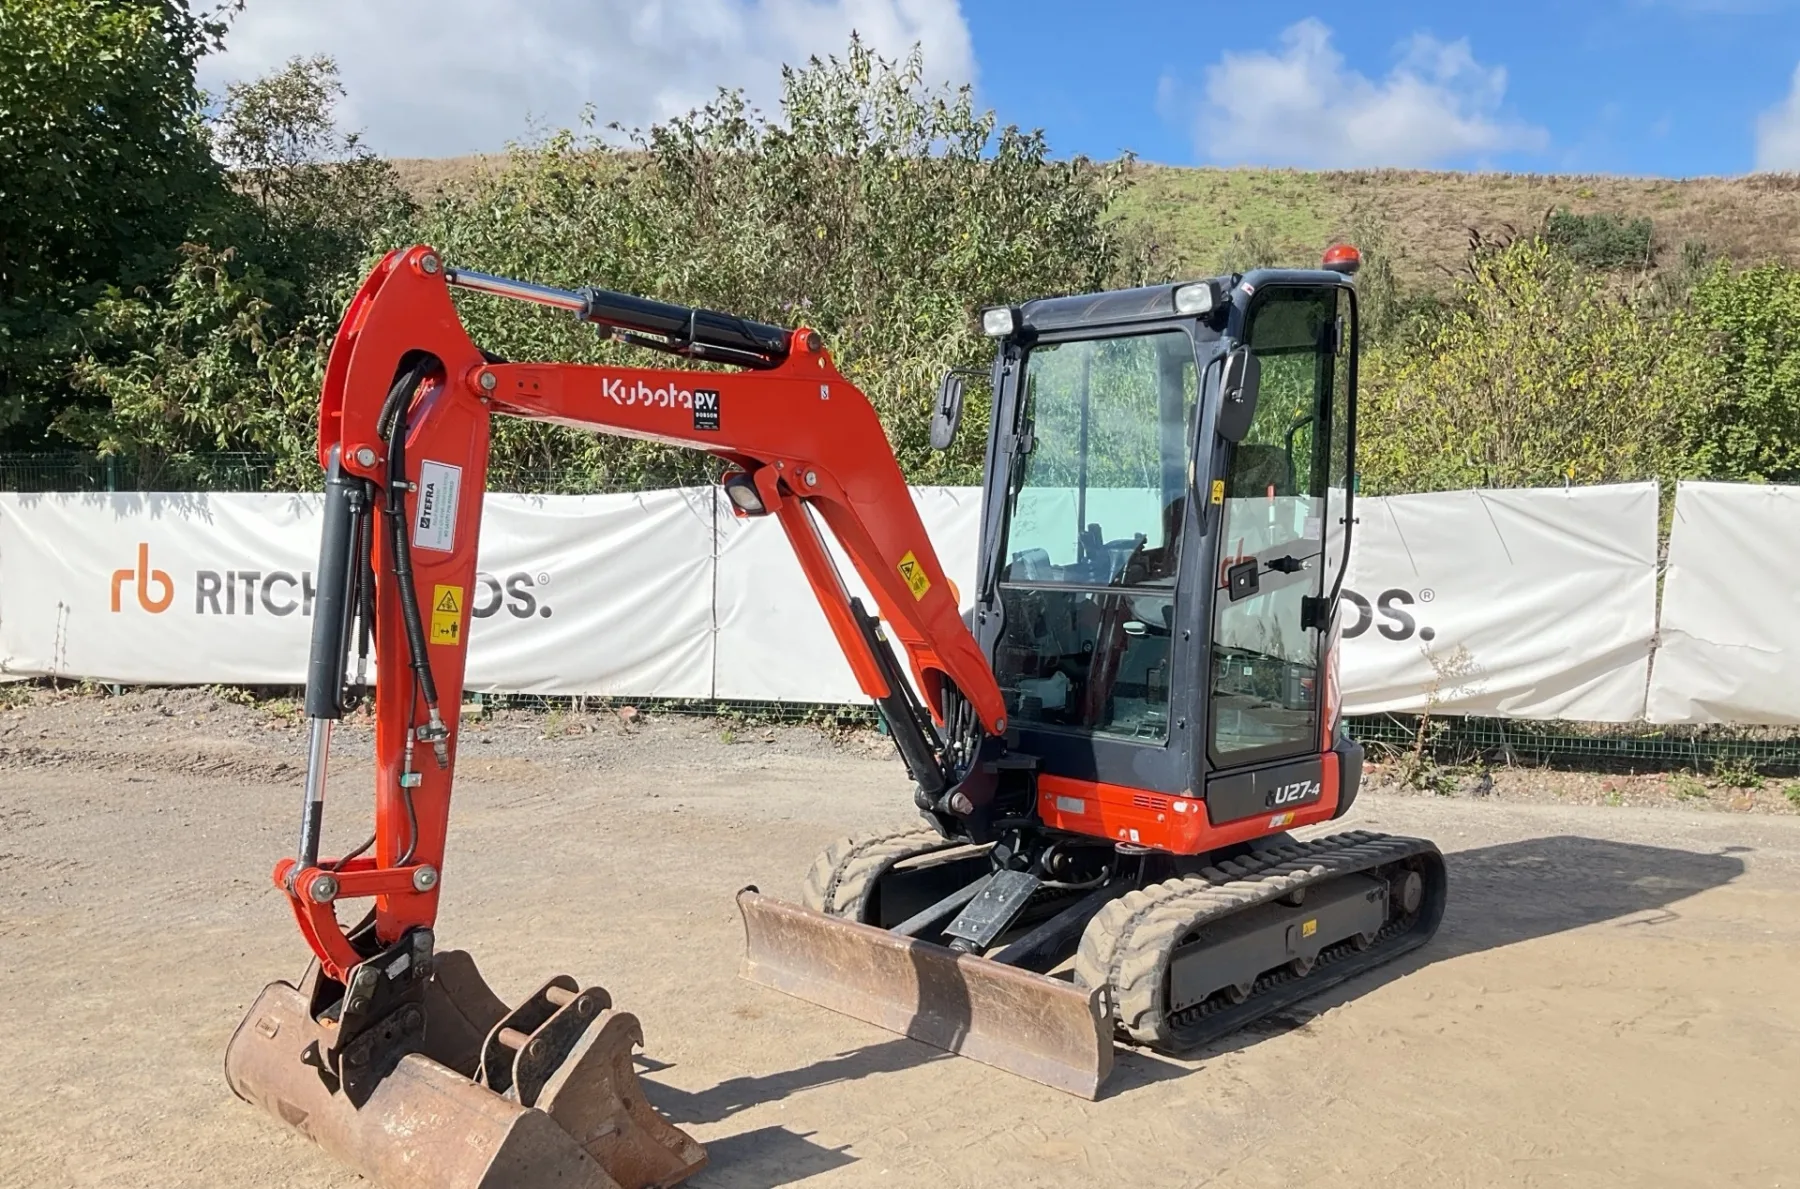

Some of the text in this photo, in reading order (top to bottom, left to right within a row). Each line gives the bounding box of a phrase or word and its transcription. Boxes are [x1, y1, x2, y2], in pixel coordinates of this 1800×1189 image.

[602, 378, 692, 409] Kubota
[694, 392, 718, 410] P.V.
[423, 483, 435, 518] TEFRA
[111, 543, 174, 614] rb
[1275, 780, 1321, 804] U27-4
